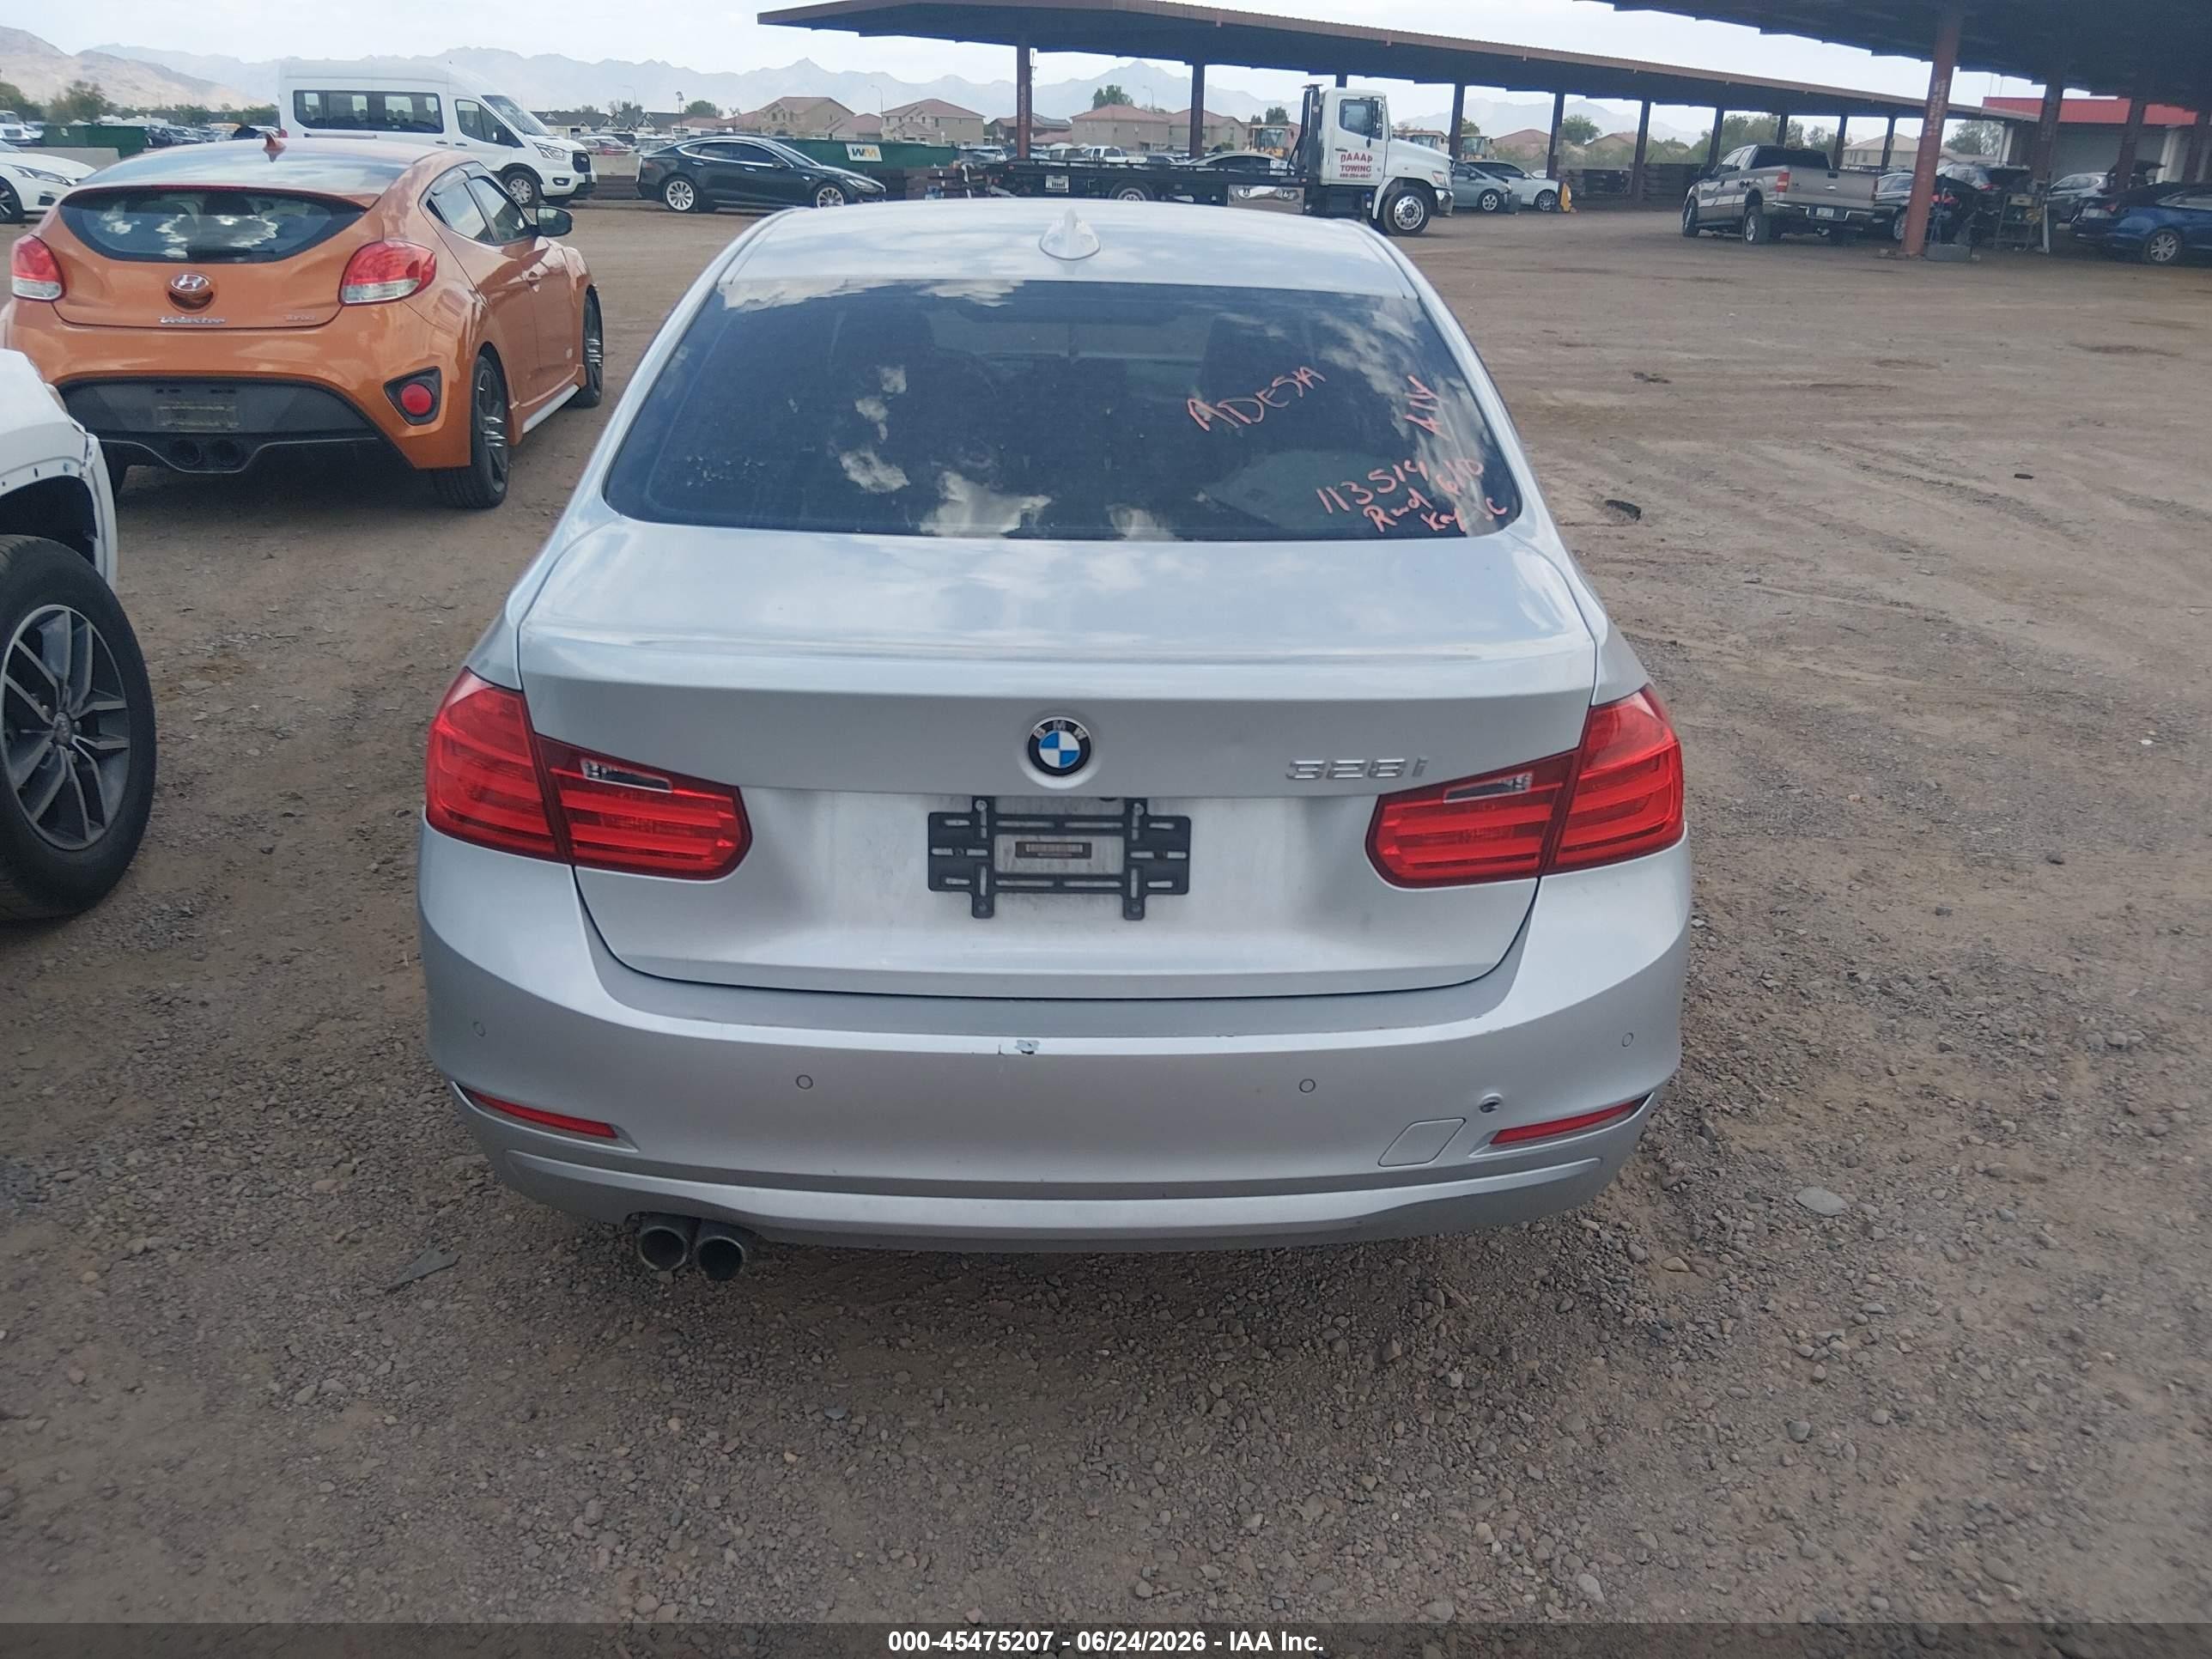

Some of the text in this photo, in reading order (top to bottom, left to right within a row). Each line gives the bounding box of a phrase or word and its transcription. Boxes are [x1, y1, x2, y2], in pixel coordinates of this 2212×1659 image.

[851, 148, 877, 157] WM
[1340, 164, 1372, 173] TOWING
[1033, 720, 1088, 741] BMW
[1285, 757, 1429, 780] 328i
